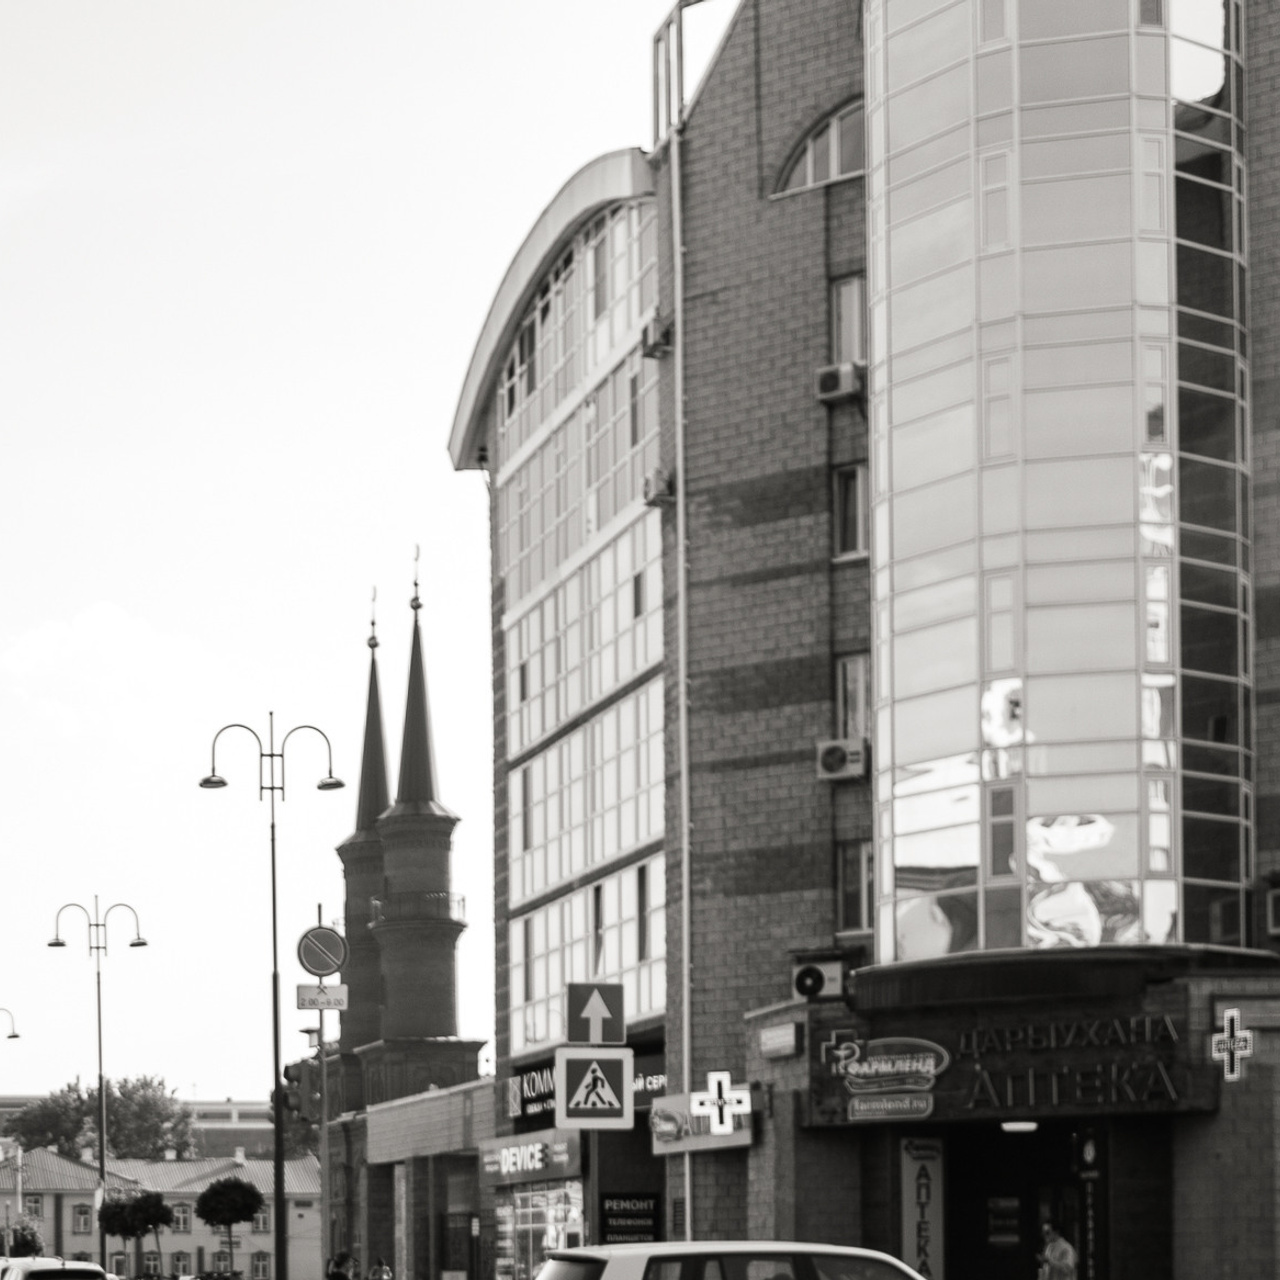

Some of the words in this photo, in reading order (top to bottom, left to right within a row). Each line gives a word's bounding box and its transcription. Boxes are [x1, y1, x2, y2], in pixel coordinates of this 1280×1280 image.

[956, 1014, 1179, 1060] ДАРЫУХАНА
[966, 1061, 1179, 1107] АПТЕКА
[501, 1142, 543, 1175] DEVICE
[604, 1199, 655, 1211] РЕМОНТ
[607, 1217, 654, 1226] ТЕЛЕФОНОВ
[915, 1164, 932, 1279] АПТЕКА
